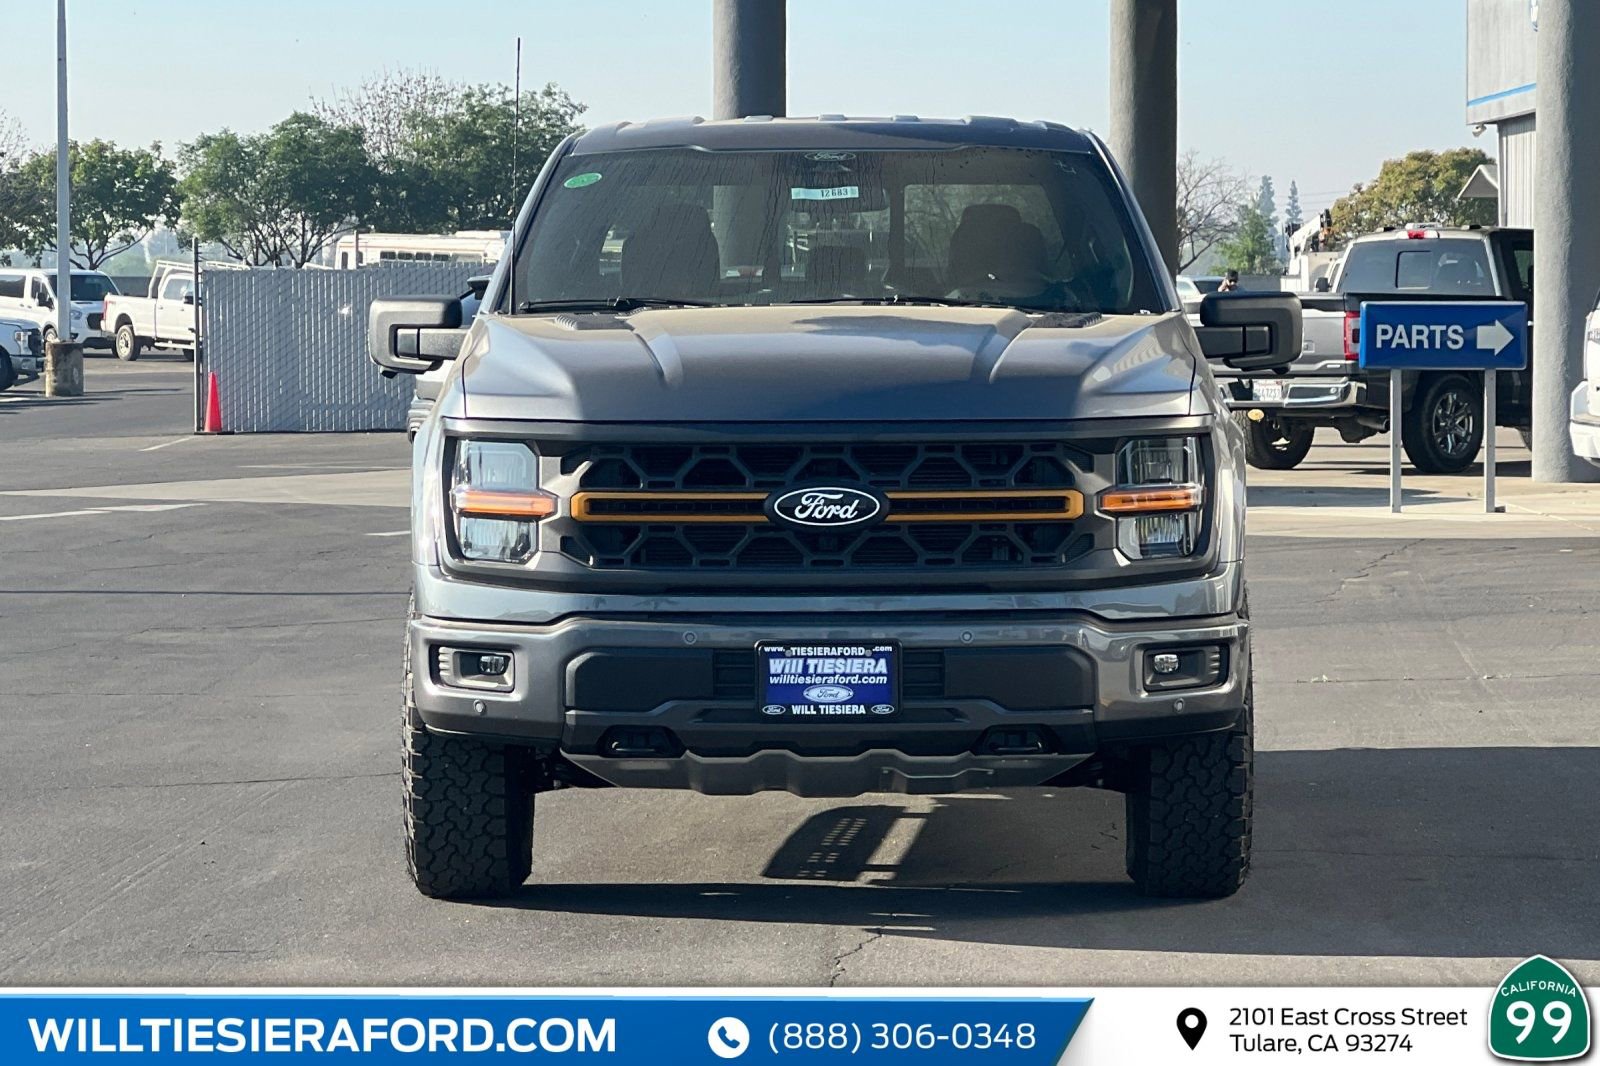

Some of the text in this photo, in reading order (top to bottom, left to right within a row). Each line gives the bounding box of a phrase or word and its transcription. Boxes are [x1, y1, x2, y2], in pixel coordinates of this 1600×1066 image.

[1376, 325, 1464, 350] PARTS
[794, 492, 860, 519] Ford
[790, 646, 866, 656] TIESIERAFORD
[806, 658, 888, 674] TIESIERA
[769, 674, 888, 685] willtiesieraford.com
[817, 689, 840, 698] Ford
[791, 705, 817, 715] WILL
[818, 705, 867, 715] TIESIERA
